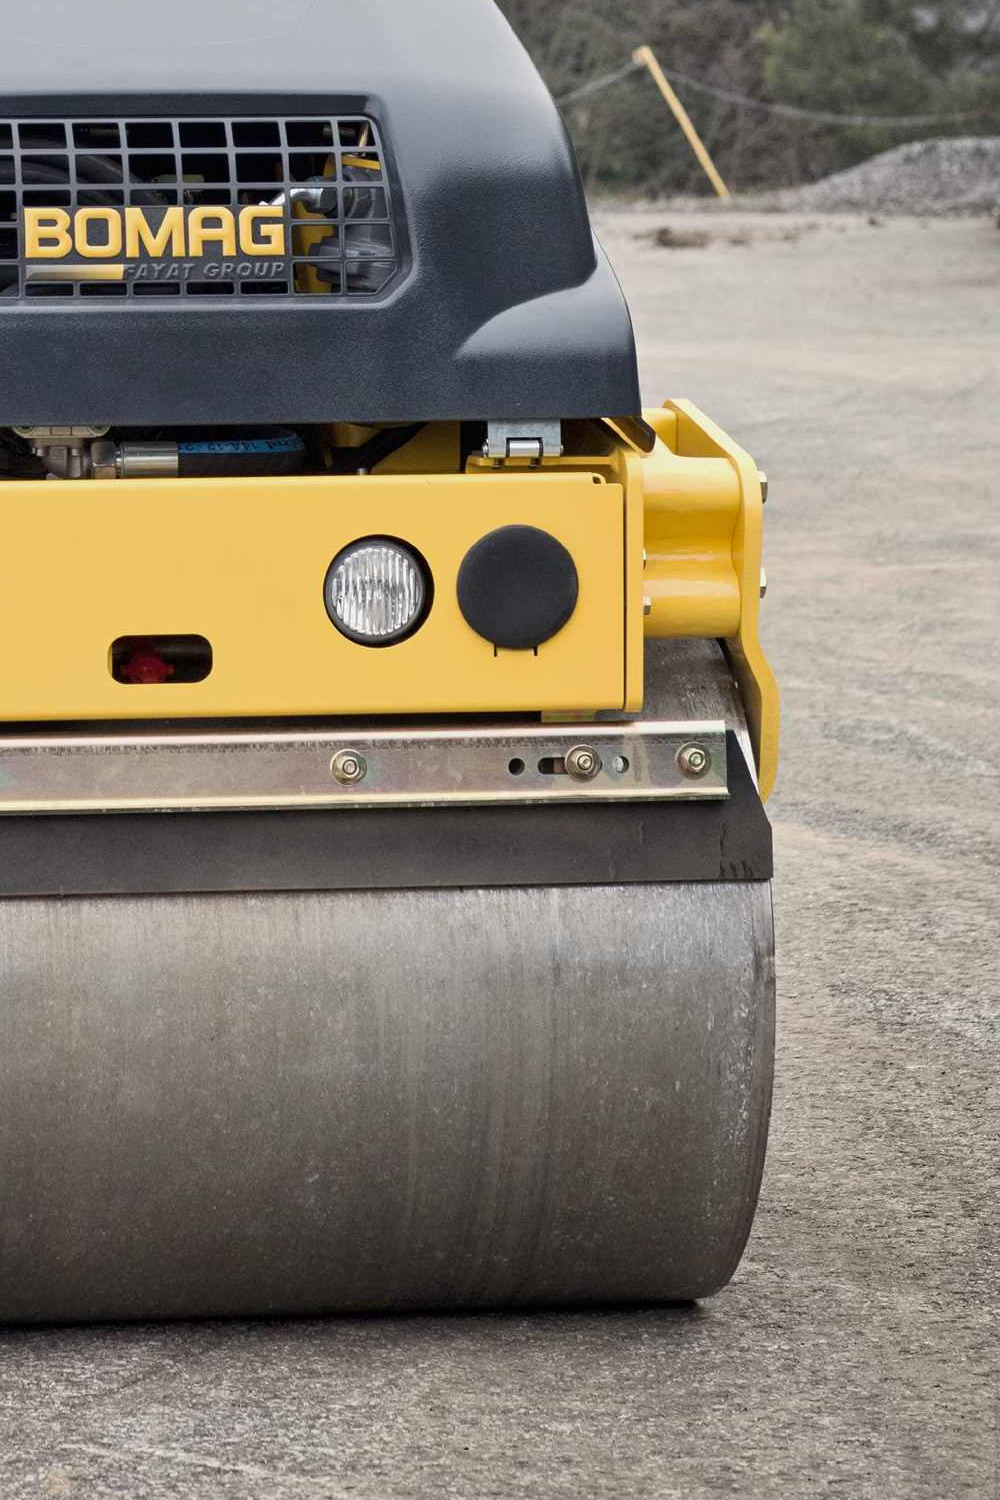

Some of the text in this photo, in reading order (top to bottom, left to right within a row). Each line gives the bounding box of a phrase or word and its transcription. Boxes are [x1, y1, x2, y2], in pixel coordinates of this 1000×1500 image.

[23, 206, 285, 259] BOMAG
[123, 262, 285, 280] FAYAT GROUP
